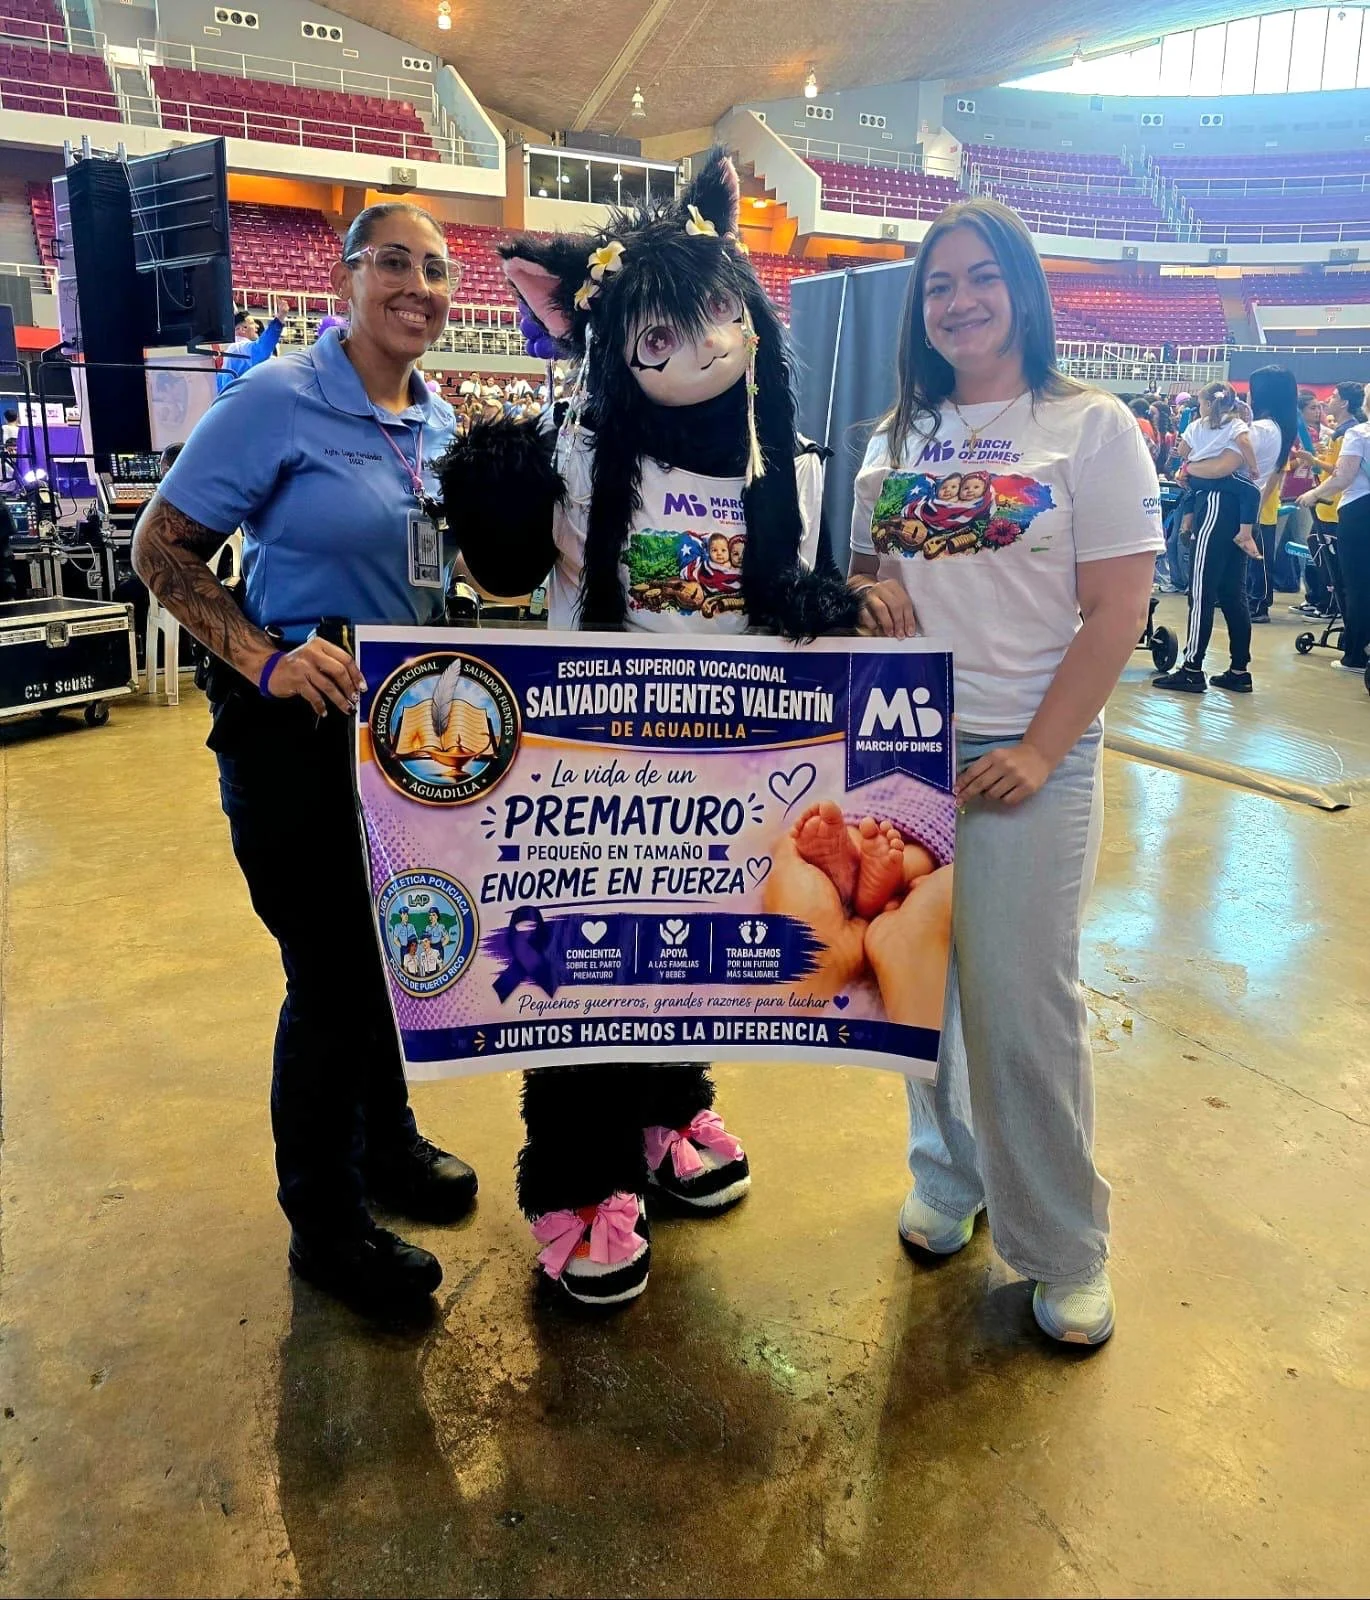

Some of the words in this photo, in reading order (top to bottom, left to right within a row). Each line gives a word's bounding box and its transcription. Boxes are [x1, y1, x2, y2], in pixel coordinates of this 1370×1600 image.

[962, 439, 1013, 450] MARCH
[958, 450, 976, 460] OF
[977, 451, 1021, 463] DIMES
[709, 496, 745, 509] MARC
[712, 509, 729, 520] OF
[558, 659, 622, 679] ESCUELA
[625, 658, 696, 677] SUPERIOR
[700, 660, 787, 684] VOCACIONAL
[377, 696, 394, 735] ESCUELA
[388, 661, 440, 695] VOCACIONAL
[463, 663, 503, 697] SALVADOR
[498, 694, 515, 736] FUENTES
[526, 683, 639, 719] SALVADOR
[644, 682, 735, 716] FUENTES
[741, 686, 834, 724] VALENTÍN
[611, 721, 634, 738] DE
[641, 721, 747, 739] AGUADILLA
[856, 740, 894, 752] MARCH
[895, 741, 910, 752] OF
[910, 741, 943, 753] DIMES
[551, 759, 578, 788] La
[583, 759, 631, 786] vida
[634, 759, 661, 787] de
[667, 767, 697, 785] un
[408, 781, 482, 800] AGUADILLA
[504, 795, 745, 839] PREMATURO
[527, 842, 605, 861] PEQUEÑO
[608, 844, 629, 861] EN
[636, 841, 703, 861] TAMAÑO
[480, 867, 600, 904] ENORME
[607, 866, 643, 896] EN
[651, 866, 745, 895] FUERZA
[379, 896, 390, 917] LIGA
[428, 876, 470, 916] POLICIACA
[407, 893, 431, 908] LAP
[566, 948, 622, 960] CONCIENTIZA
[660, 948, 688, 959] APOYA
[726, 947, 781, 959] TRABAJEMOS
[566, 961, 588, 970] SOBRE
[590, 961, 598, 969] EL
[599, 960, 622, 969] PARTO
[648, 960, 654, 969] A
[654, 960, 668, 969] LAS
[668, 960, 700, 969] FAMILIAS
[727, 960, 741, 969] POR
[742, 960, 752, 969] UN
[753, 960, 779, 969] FUTURO
[409, 981, 419, 991] DE
[420, 975, 449, 991] PUERTO
[447, 955, 466, 978] RICO
[573, 970, 614, 981] PREMATURO
[660, 970, 665, 979] Y
[665, 969, 686, 979] BEBÉS
[726, 969, 741, 979] MÁS
[742, 970, 780, 979] SALUDABLE
[518, 994, 580, 1017] Pequeños
[583, 996, 649, 1016] guerreros,
[653, 992, 703, 1015] grandes
[706, 993, 751, 1008] razones
[753, 994, 785, 1014] para
[788, 992, 830, 1010] luchar
[494, 1024, 573, 1049] JUNTOS
[580, 1021, 676, 1043] HACEMOS
[682, 1022, 706, 1042] LA
[713, 1021, 830, 1043] DIFERENCIA
